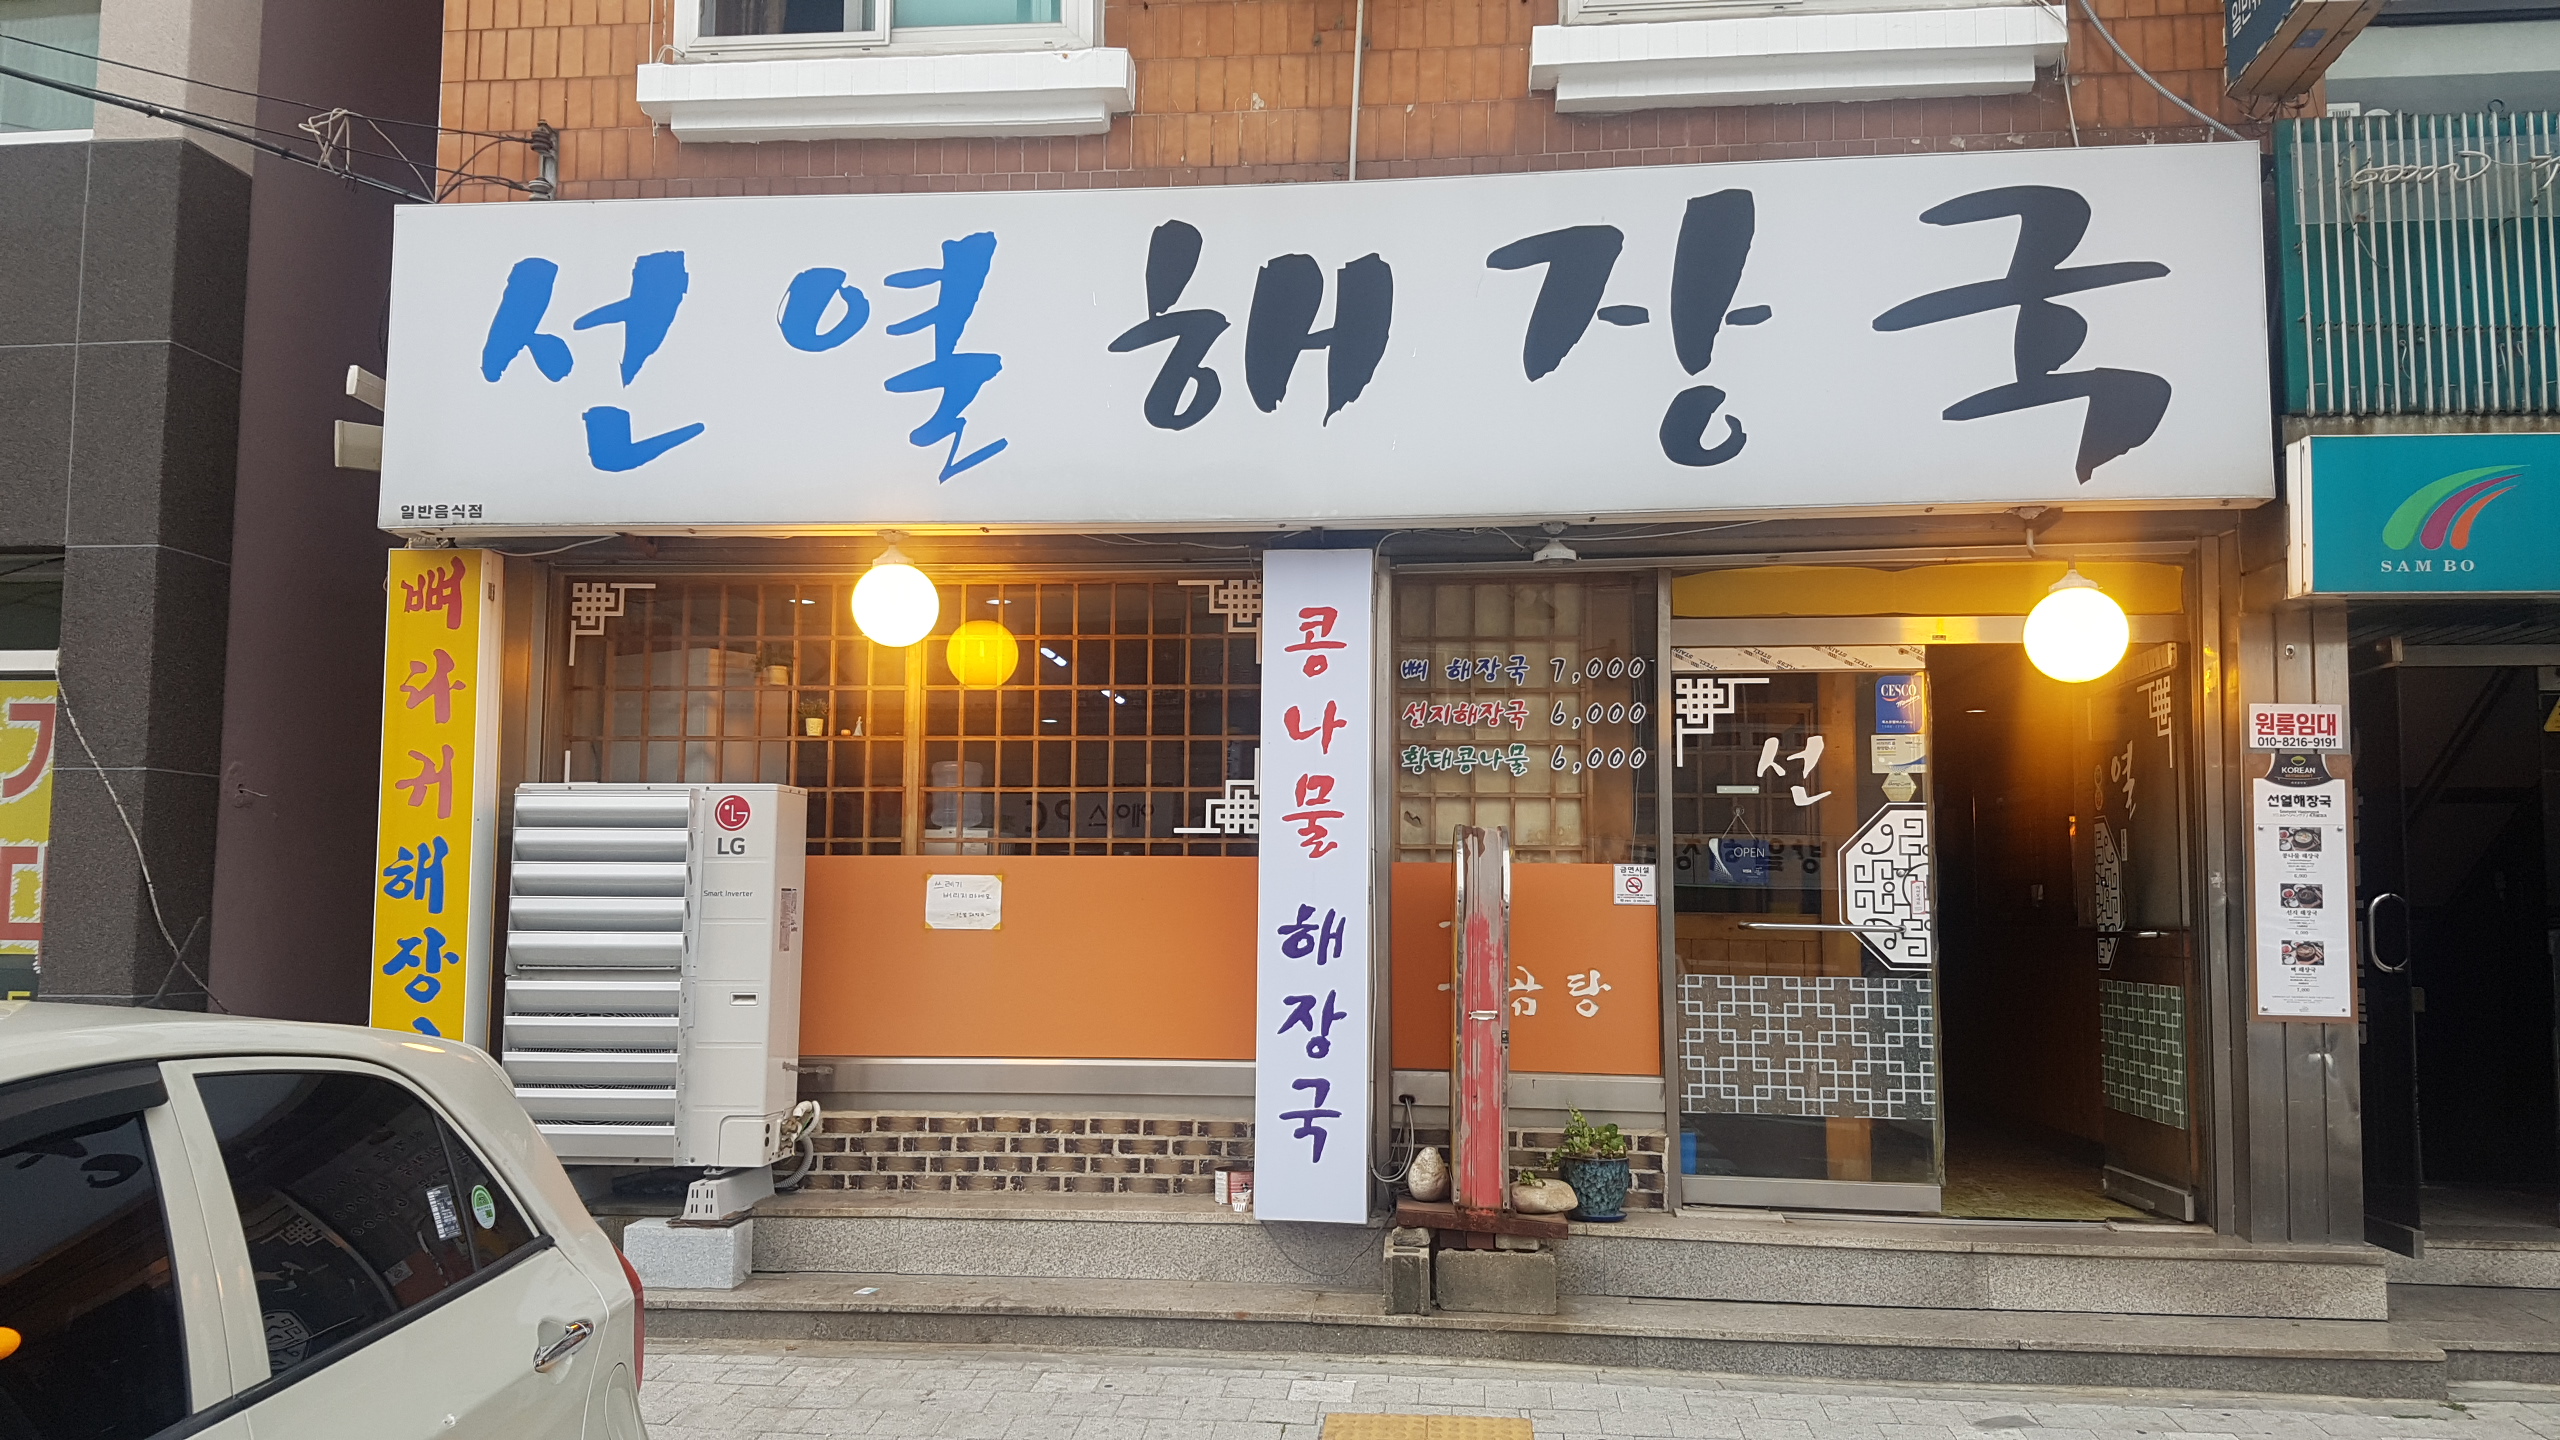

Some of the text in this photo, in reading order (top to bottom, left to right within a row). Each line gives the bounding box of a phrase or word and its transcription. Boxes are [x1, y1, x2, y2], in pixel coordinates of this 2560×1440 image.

[1109, 186, 2171, 483] 해장국
[400, 503, 483, 519] 일반음식점
[2380, 559, 2476, 573] SAM BO
[1400, 653, 1647, 686] 뼈 해장국 7,000
[1880, 684, 1917, 697] CESCO
[1401, 698, 1648, 731] 선지해장국 6,000
[2255, 712, 2337, 737] 원룸임대
[2257, 737, 2337, 747] 010-8216-9191
[1401, 742, 1648, 777] 황태콩나물 6,000
[1756, 734, 1833, 807] 선
[2281, 766, 2316, 775] KOREAN
[2110, 739, 2137, 821] 열
[382, 555, 467, 1037] 뼈다귀 해장
[2267, 794, 2332, 808] 선열해장국
[717, 837, 746, 855] LG
[1733, 846, 1766, 858] OPEN
[1619, 866, 1650, 874] 금연시설
[933, 880, 963, 889] 쓰레기
[1277, 606, 1348, 1164] 콩나물 해장국
[703, 889, 754, 898] Smart Inverter
